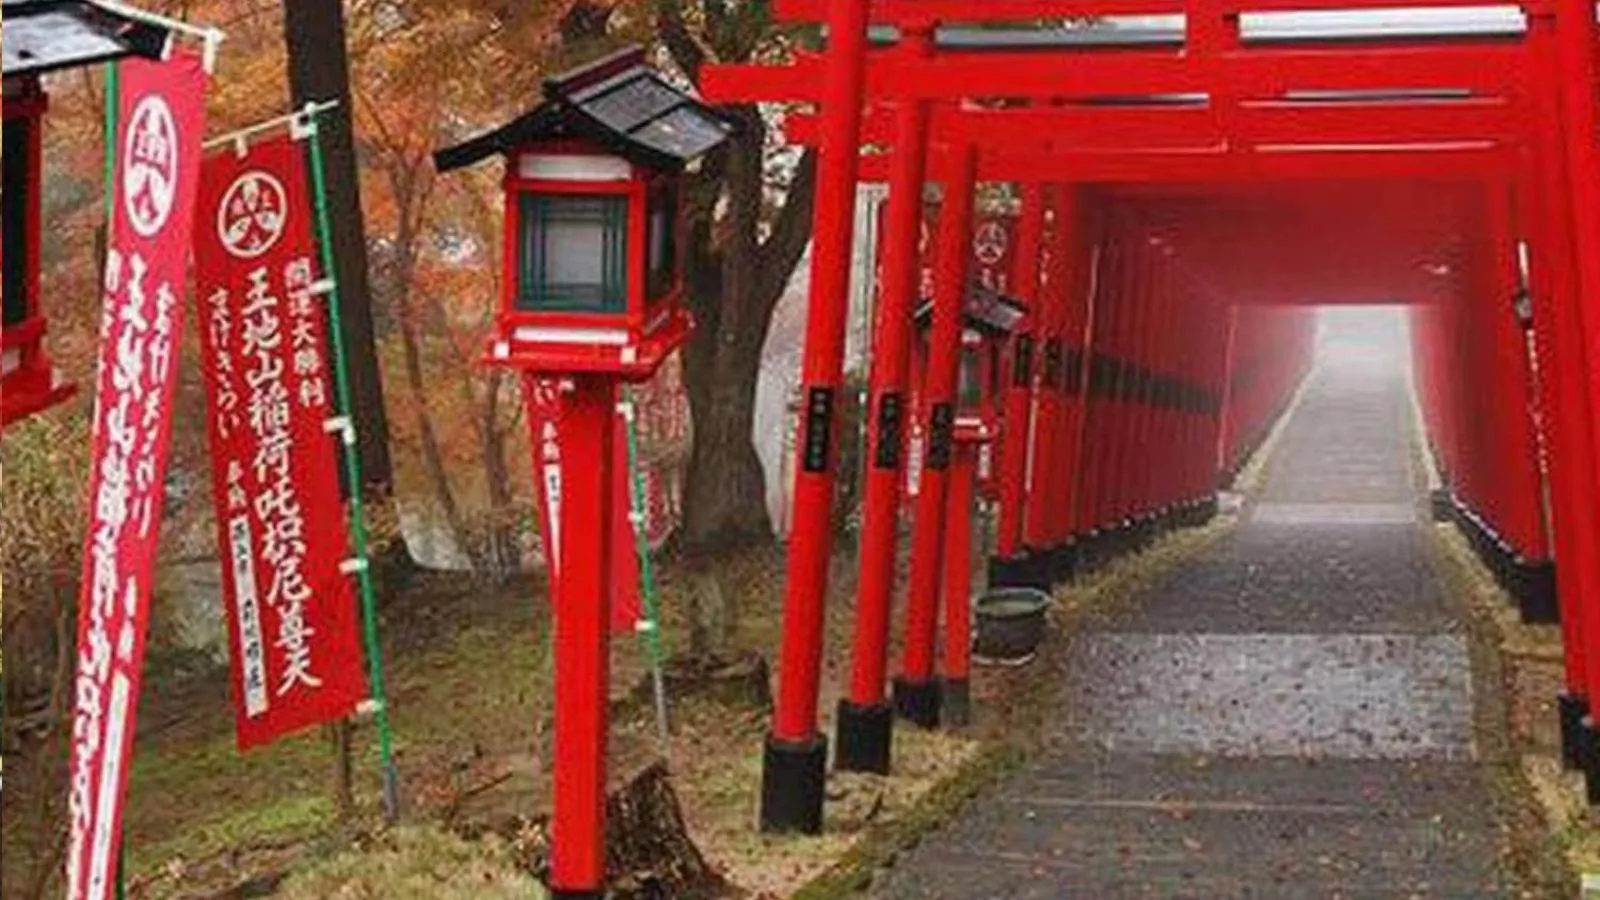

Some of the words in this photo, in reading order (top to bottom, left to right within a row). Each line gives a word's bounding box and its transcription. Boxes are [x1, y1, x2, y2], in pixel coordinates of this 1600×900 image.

[208, 287, 241, 439] まけきらい
